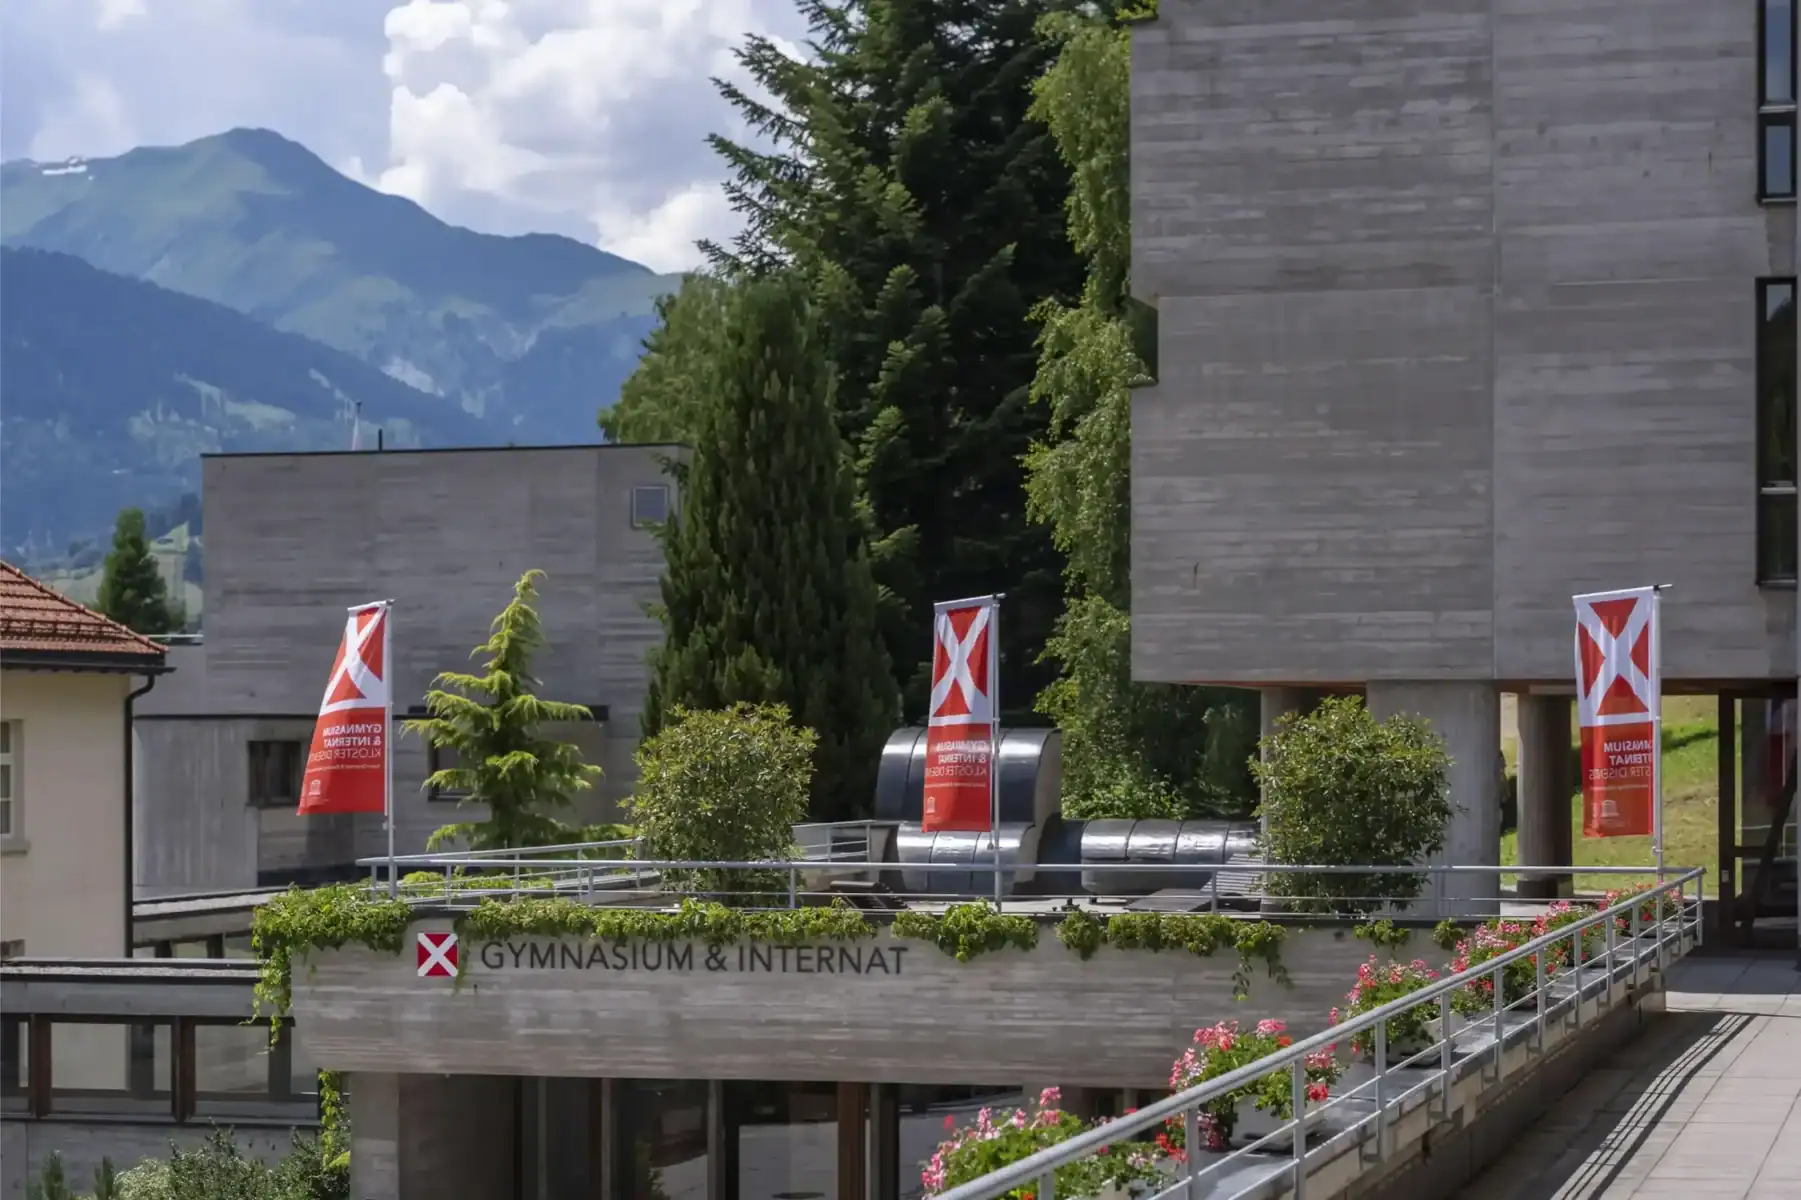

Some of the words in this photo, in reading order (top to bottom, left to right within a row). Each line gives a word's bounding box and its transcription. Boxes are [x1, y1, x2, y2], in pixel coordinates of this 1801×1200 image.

[481, 942, 694, 971] GYMNASIUM
[705, 944, 727, 971] &
[738, 945, 909, 975] INTERNAT
